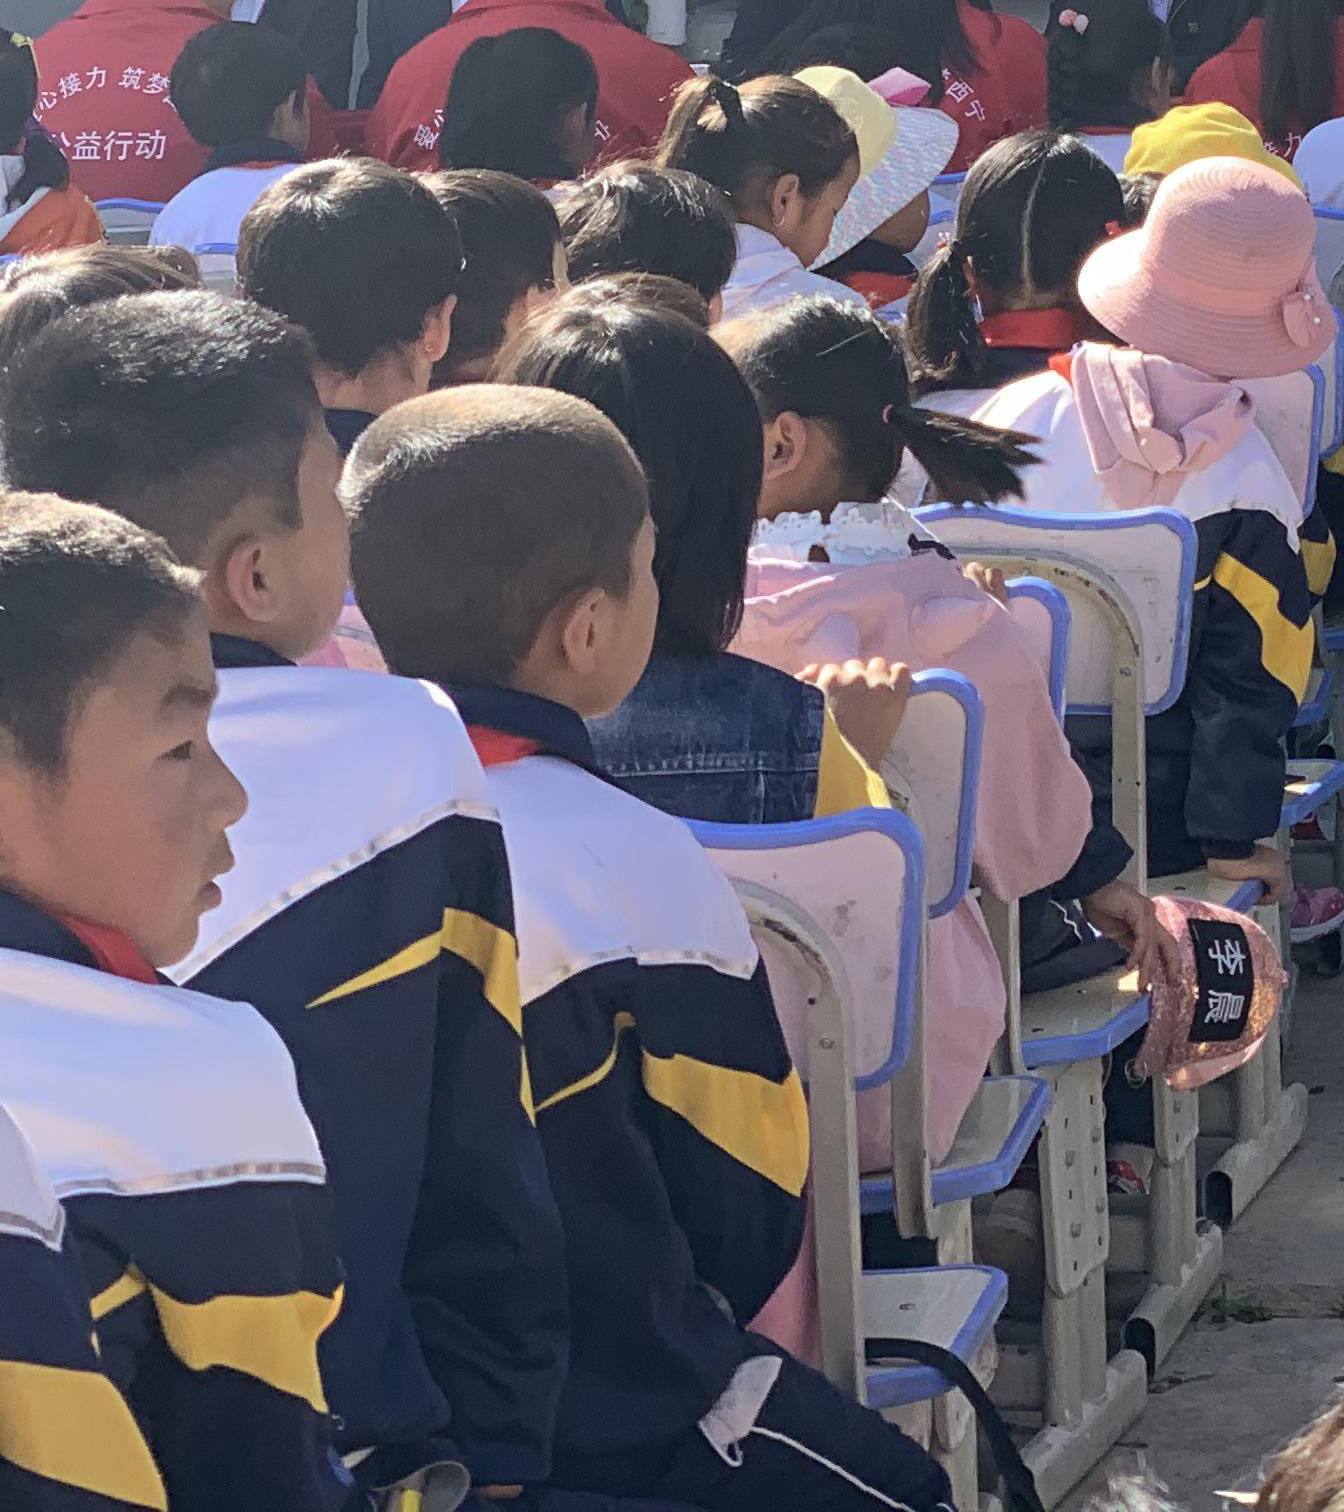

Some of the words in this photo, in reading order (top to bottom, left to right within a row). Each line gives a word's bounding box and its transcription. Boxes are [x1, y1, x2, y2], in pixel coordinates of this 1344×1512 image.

[118, 66, 178, 113] 筑梦
[941, 67, 987, 122] 西宁
[1203, 938, 1247, 1025] 李晨
